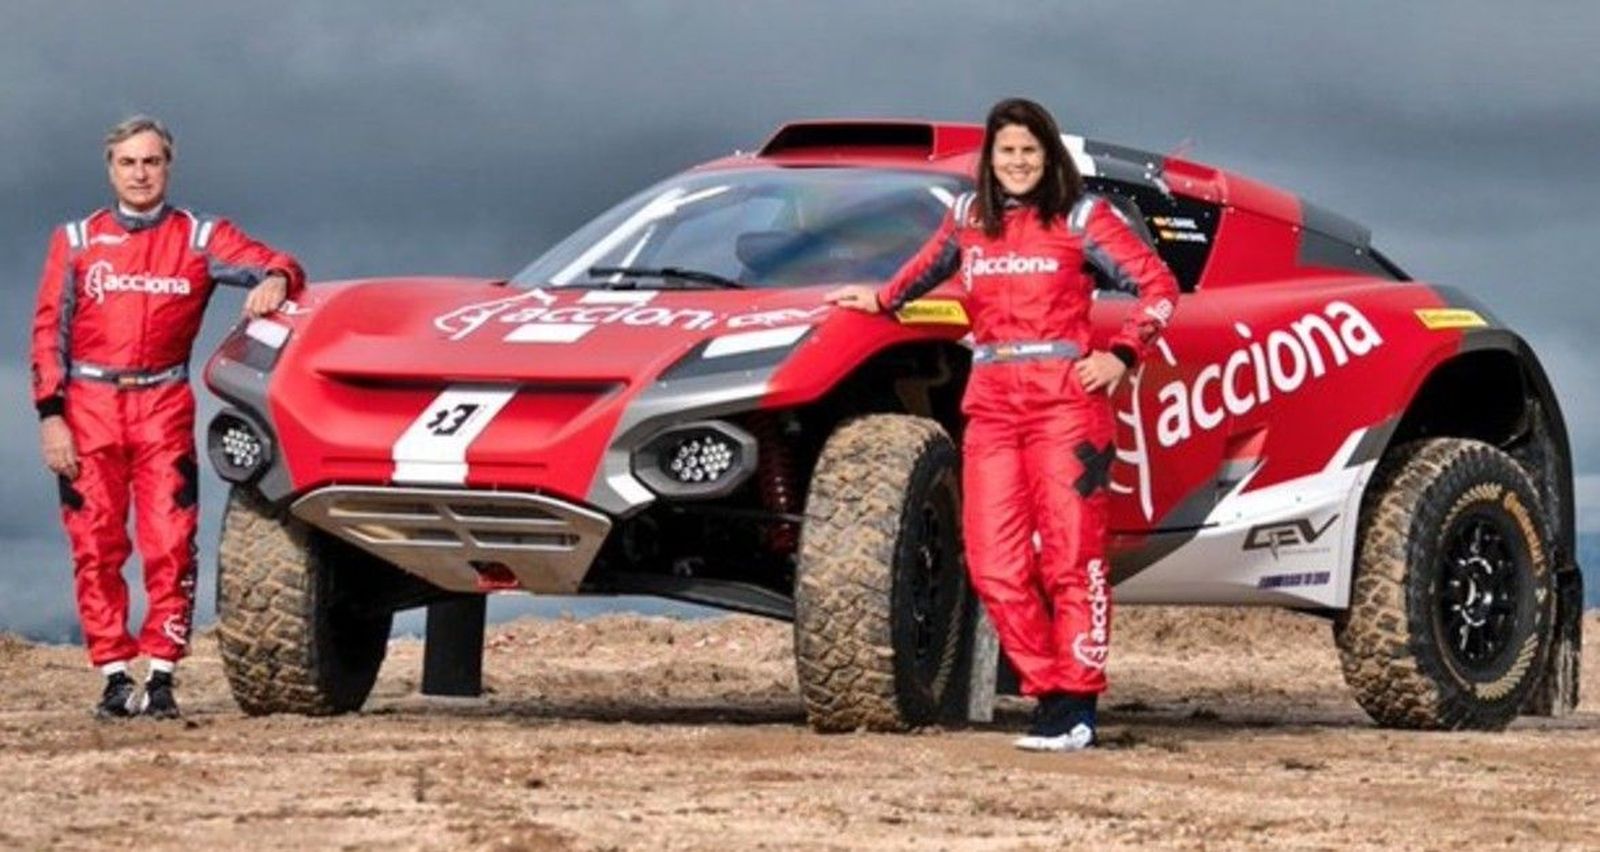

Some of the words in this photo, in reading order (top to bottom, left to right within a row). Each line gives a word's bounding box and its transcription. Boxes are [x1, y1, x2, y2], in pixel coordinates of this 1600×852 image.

[972, 252, 1059, 275] acciona
[103, 272, 190, 294] acciona
[1156, 300, 1383, 447] acciona
[1242, 513, 1340, 554] GEV
